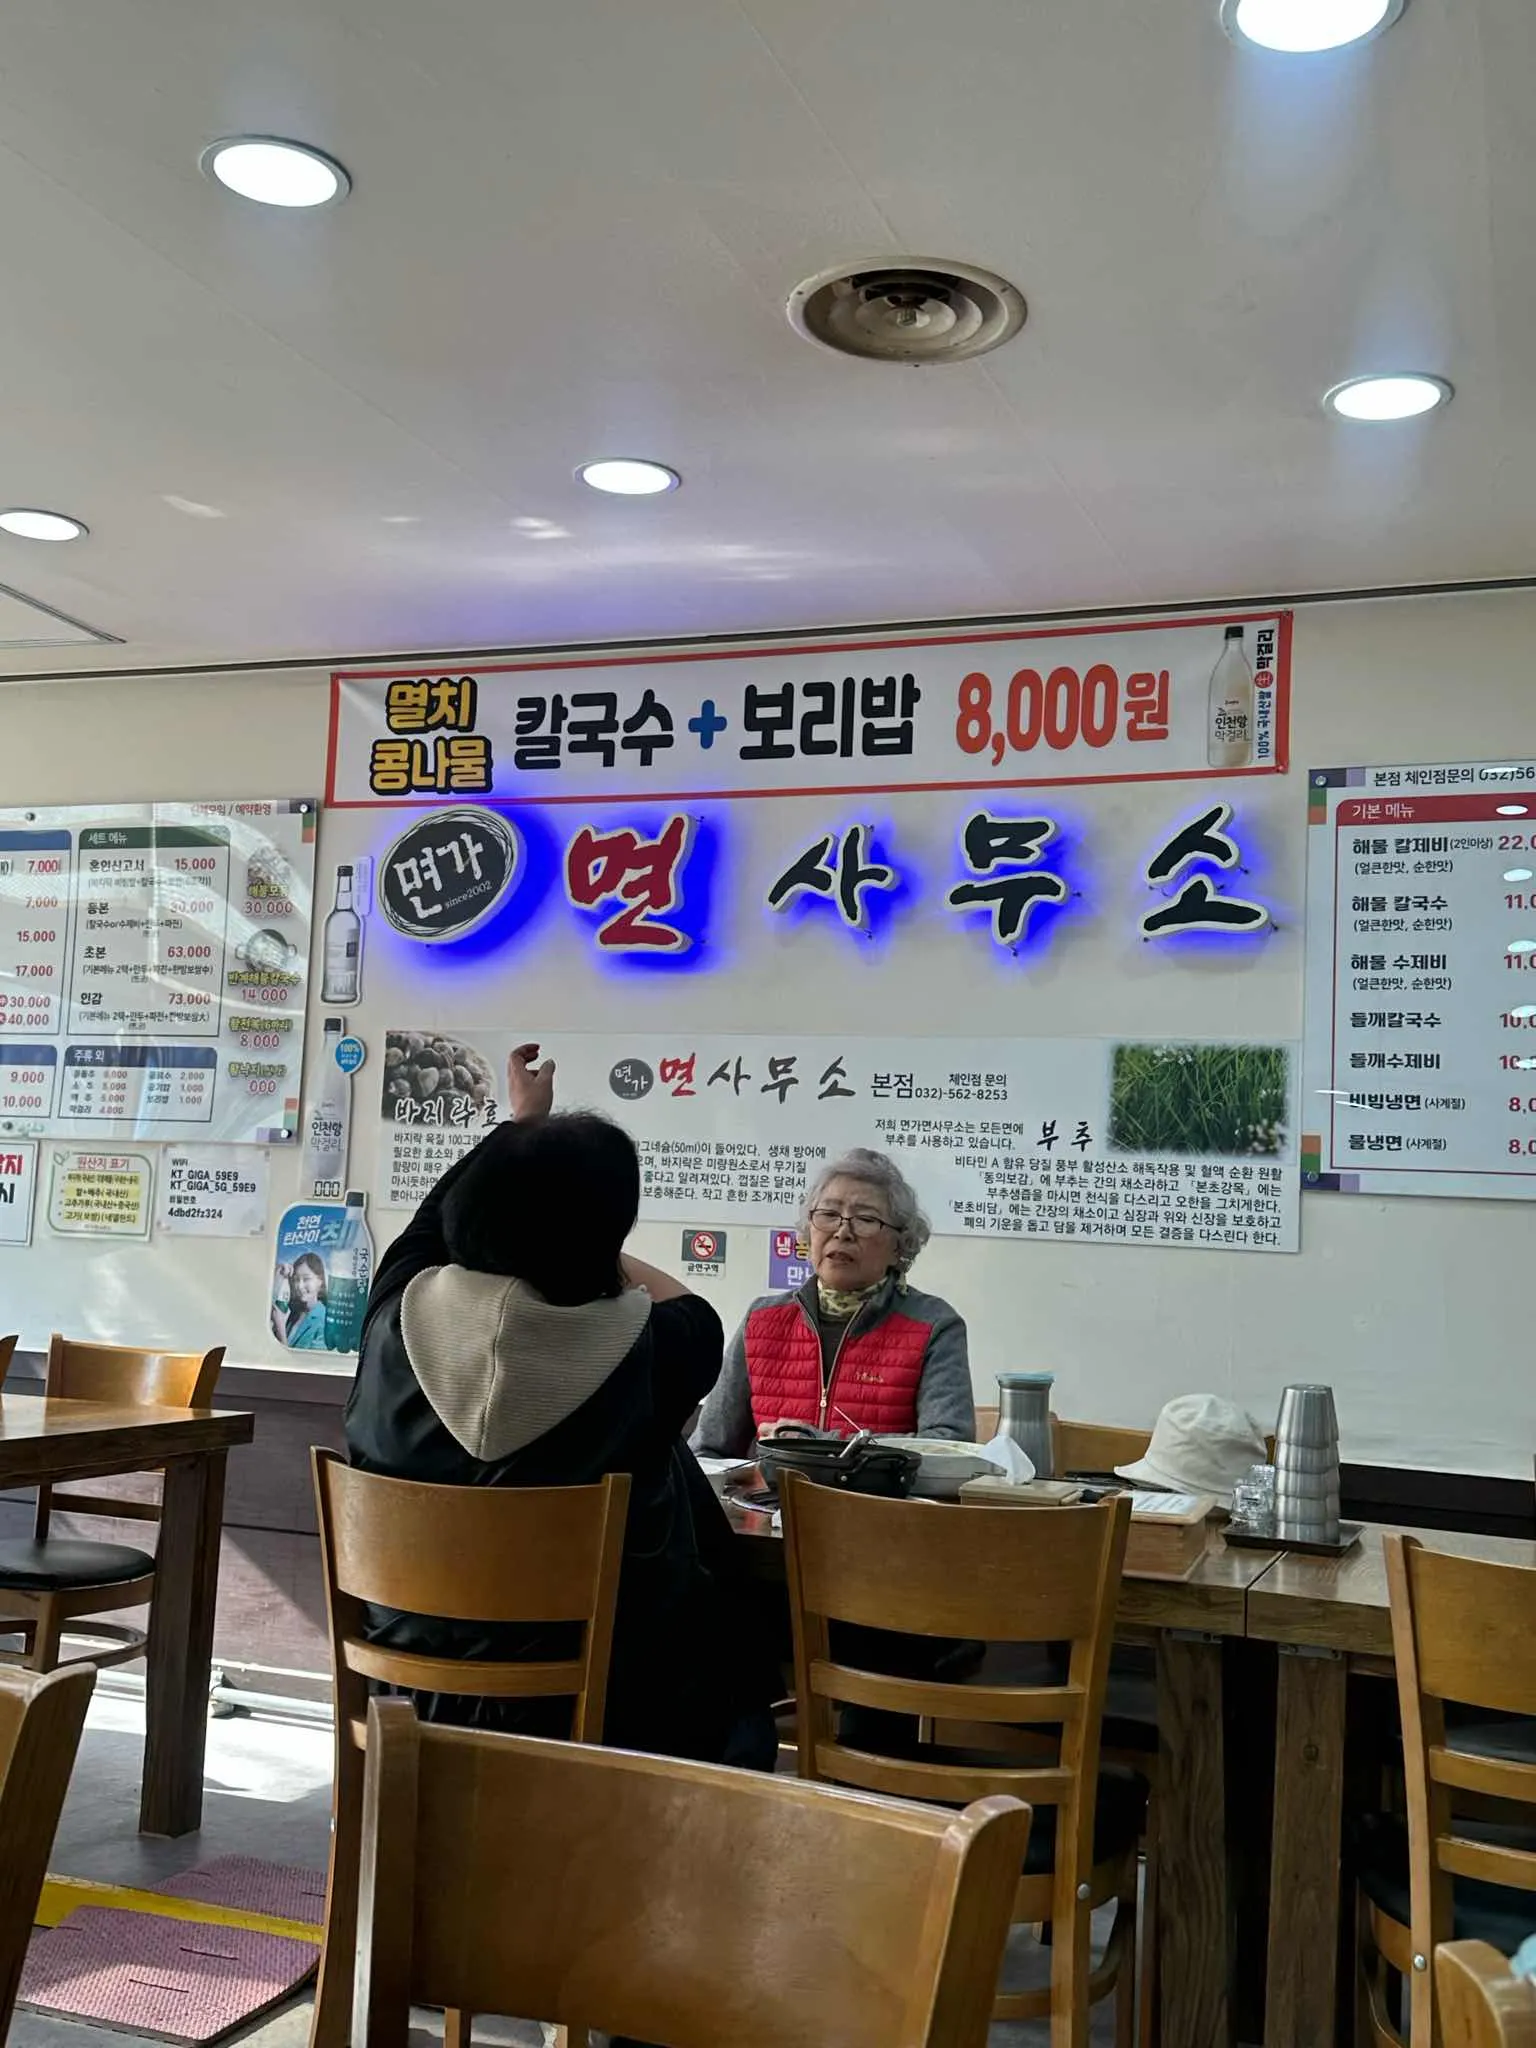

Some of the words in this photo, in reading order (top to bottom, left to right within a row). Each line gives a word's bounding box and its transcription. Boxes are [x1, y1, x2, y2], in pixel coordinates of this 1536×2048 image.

[1256, 630, 1274, 669] 막걸리
[386, 676, 477, 735] 멸치
[514, 688, 674, 769] 칼국수
[739, 672, 921, 761] 보리밥
[955, 664, 1169, 766] 8,000원
[1258, 732, 1270, 759] 100%
[370, 736, 492, 795] 콩나물
[1373, 770, 1401, 787] 본점
[1404, 767, 1474, 785] 체인점문의
[1352, 803, 1382, 819] 기본
[1385, 803, 1416, 818] 메뉴
[88, 832, 107, 844] 세트
[109, 832, 128, 844] 메뉴
[1352, 838, 1388, 854] 해물
[89, 859, 145, 872] 혼인신고서
[174, 857, 216, 871] 15,000
[1354, 861, 1409, 875] (얼큰한맛,
[1413, 860, 1453, 874] 순한맛)
[393, 832, 484, 919] 면가
[87, 902, 110, 915] 등본
[1352, 896, 1388, 912] 해물
[1394, 895, 1448, 911] 칼국수
[1353, 918, 1408, 932] (얼큰한맛,
[1412, 917, 1453, 932] 순한맛)
[17, 931, 56, 943] 15,000
[84, 946, 107, 959] 초본
[168, 946, 211, 958] 63,000
[1351, 954, 1387, 971] 해물
[1392, 954, 1447, 970] 수제비
[15, 965, 53, 977] 17,000
[1352, 978, 1407, 991] (얼큰한맛,
[1411, 977, 1452, 991] 순한맛)
[80, 992, 103, 1005] 인감
[169, 993, 210, 1005] 73,000
[1350, 1012, 1441, 1029] 들깨칼국수
[240, 1034, 280, 1047] 8,000
[74, 1049, 93, 1063] 주류
[1350, 1053, 1441, 1070] 들깨수제비
[614, 1064, 652, 1092] 면가
[949, 1073, 981, 1087] 체인점
[984, 1073, 1007, 1087] 문의
[871, 1073, 914, 1099] 본점
[915, 1087, 1008, 1101] 032)-562-8253
[1349, 1093, 1421, 1111] 비빔냉면
[1424, 1098, 1465, 1110] (사계절)
[875, 1119, 896, 1131] 저희
[900, 1120, 976, 1134] 면가면사무소는
[979, 1122, 1024, 1136] 모든면에
[394, 1133, 422, 1145] 바지락
[886, 1134, 917, 1147] 부추를
[921, 1135, 964, 1148] 사용하고
[968, 1137, 1015, 1150] 있습니다.
[1348, 1135, 1402, 1152] 물냉면
[1406, 1138, 1447, 1150] (사계절)
[635, 1141, 711, 1154] 그네슘(50ml)이
[424, 1161, 442, 1174] 매우
[661, 1158, 703, 1170] 바지락은
[773, 1160, 806, 1173] 무기질
[954, 1156, 987, 1169] 비타민
[991, 1157, 999, 1169] A
[1003, 1157, 1025, 1171] 함유
[1029, 1158, 1051, 1172] 당질
[1055, 1159, 1078, 1172] 풍부
[1082, 1160, 1128, 1174] 활성산소
[1132, 1162, 1180, 1177] 해독작용
[1184, 1164, 1196, 1177] 및
[1200, 1165, 1224, 1179] 혈액
[1228, 1166, 1253, 1180] 순환
[1257, 1167, 1282, 1181] 원활
[738, 1174, 770, 1187] 껍질은
[1055, 1175, 1089, 1189] 부추는
[1094, 1176, 1116, 1190] 간의
[1120, 1178, 1179, 1192] 채소라하고
[1257, 1183, 1282, 1197] 에는
[702, 1187, 722, 1200] 작고
[751, 1190, 794, 1204] 조개지만
[987, 1187, 1042, 1201] 부추생즙을
[1047, 1190, 1081, 1203] 마시면
[1086, 1191, 1120, 1205] 천식을
[1124, 1194, 1171, 1208] 다스리고
[1175, 1196, 1211, 1210] 오한을
[1215, 1197, 1281, 1213] 그치게한다.
[296, 1214, 322, 1230] 천연
[1035, 1204, 1069, 1218] 간장의
[1073, 1206, 1119, 1220] 채소이고
[1123, 1208, 1159, 1223] 심장과
[1164, 1211, 1187, 1224] 위와
[1191, 1212, 1227, 1226] 신장을
[1232, 1214, 1281, 1229] 보호하고
[283, 1229, 321, 1246] 탄산이
[964, 1217, 986, 1230] 폐의
[990, 1218, 1023, 1232] 기운을
[1027, 1220, 1050, 1233] 돕고
[1054, 1221, 1076, 1235] 담을
[1080, 1223, 1127, 1237] 제거하며
[1131, 1225, 1155, 1239] 모든
[1199, 1228, 1247, 1244] 다스린다
[1253, 1231, 1281, 1246] 한다.
[688, 1263, 719, 1273] 금연구역
